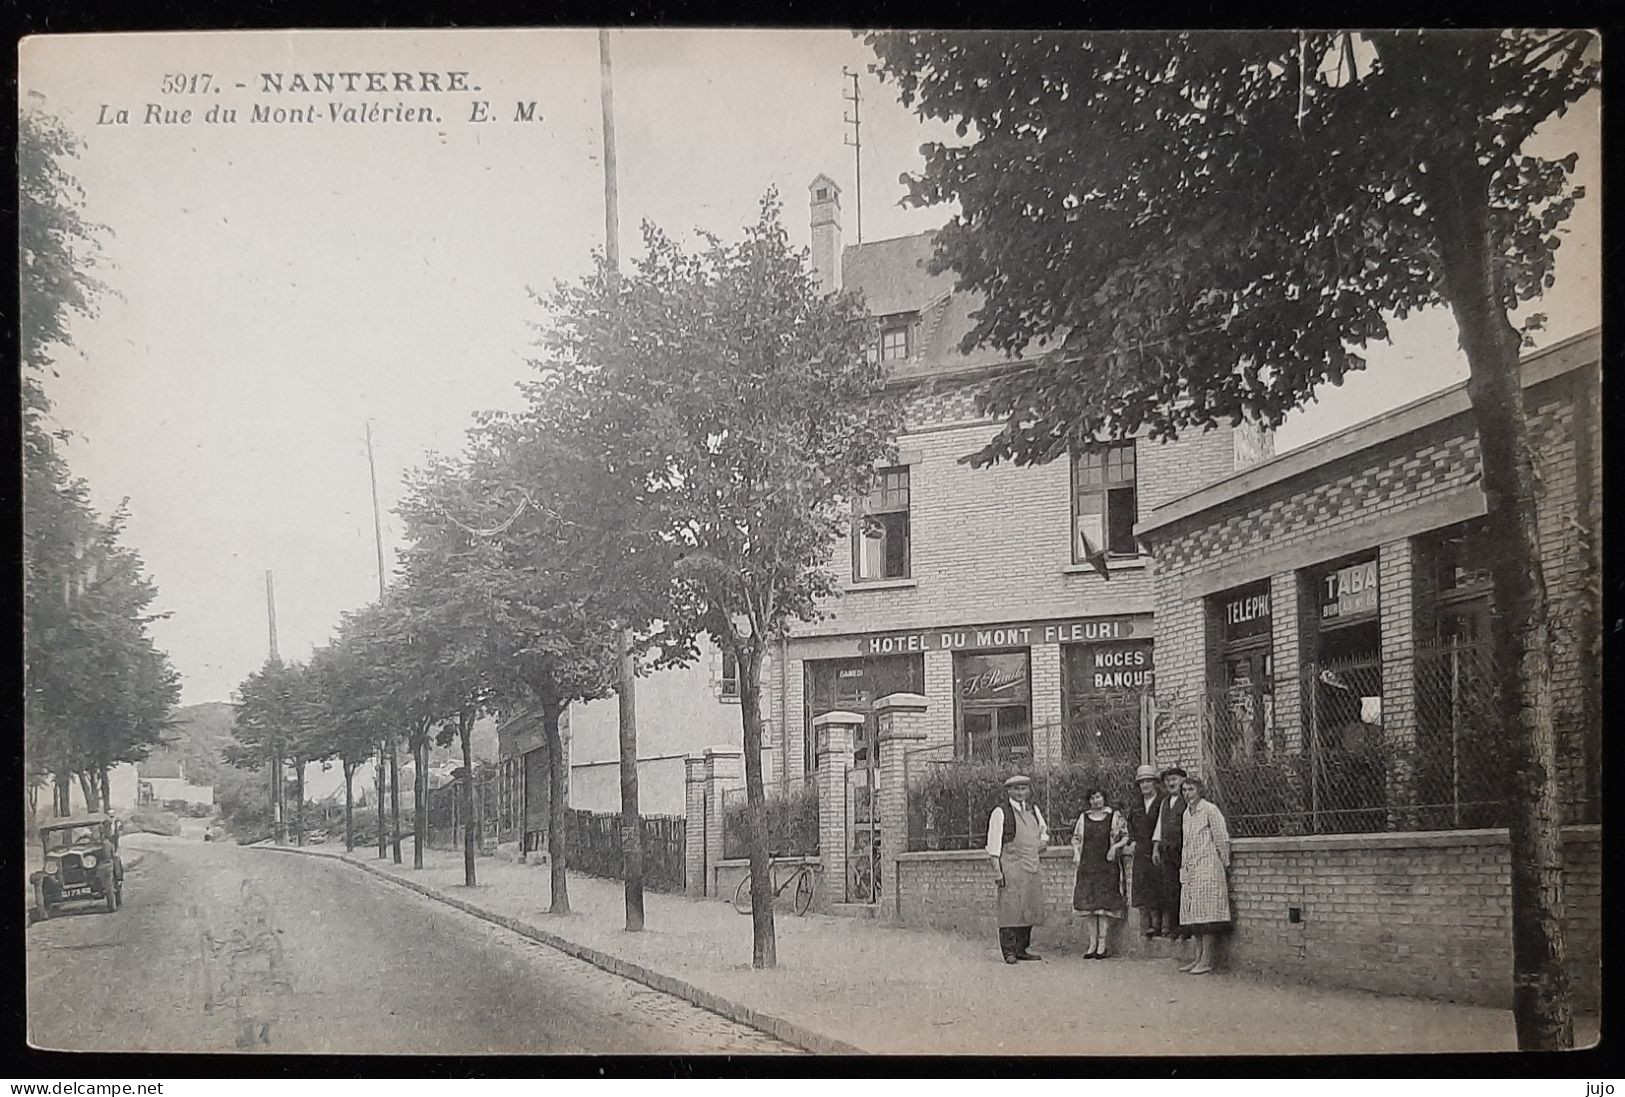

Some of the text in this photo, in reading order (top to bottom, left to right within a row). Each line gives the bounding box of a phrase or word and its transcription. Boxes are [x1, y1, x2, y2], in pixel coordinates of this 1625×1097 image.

[869, 621, 1119, 653] HOTEL DU MONT FLEURI
[1095, 651, 1145, 668] NOCES
[1094, 669, 1155, 688] BANQUE
